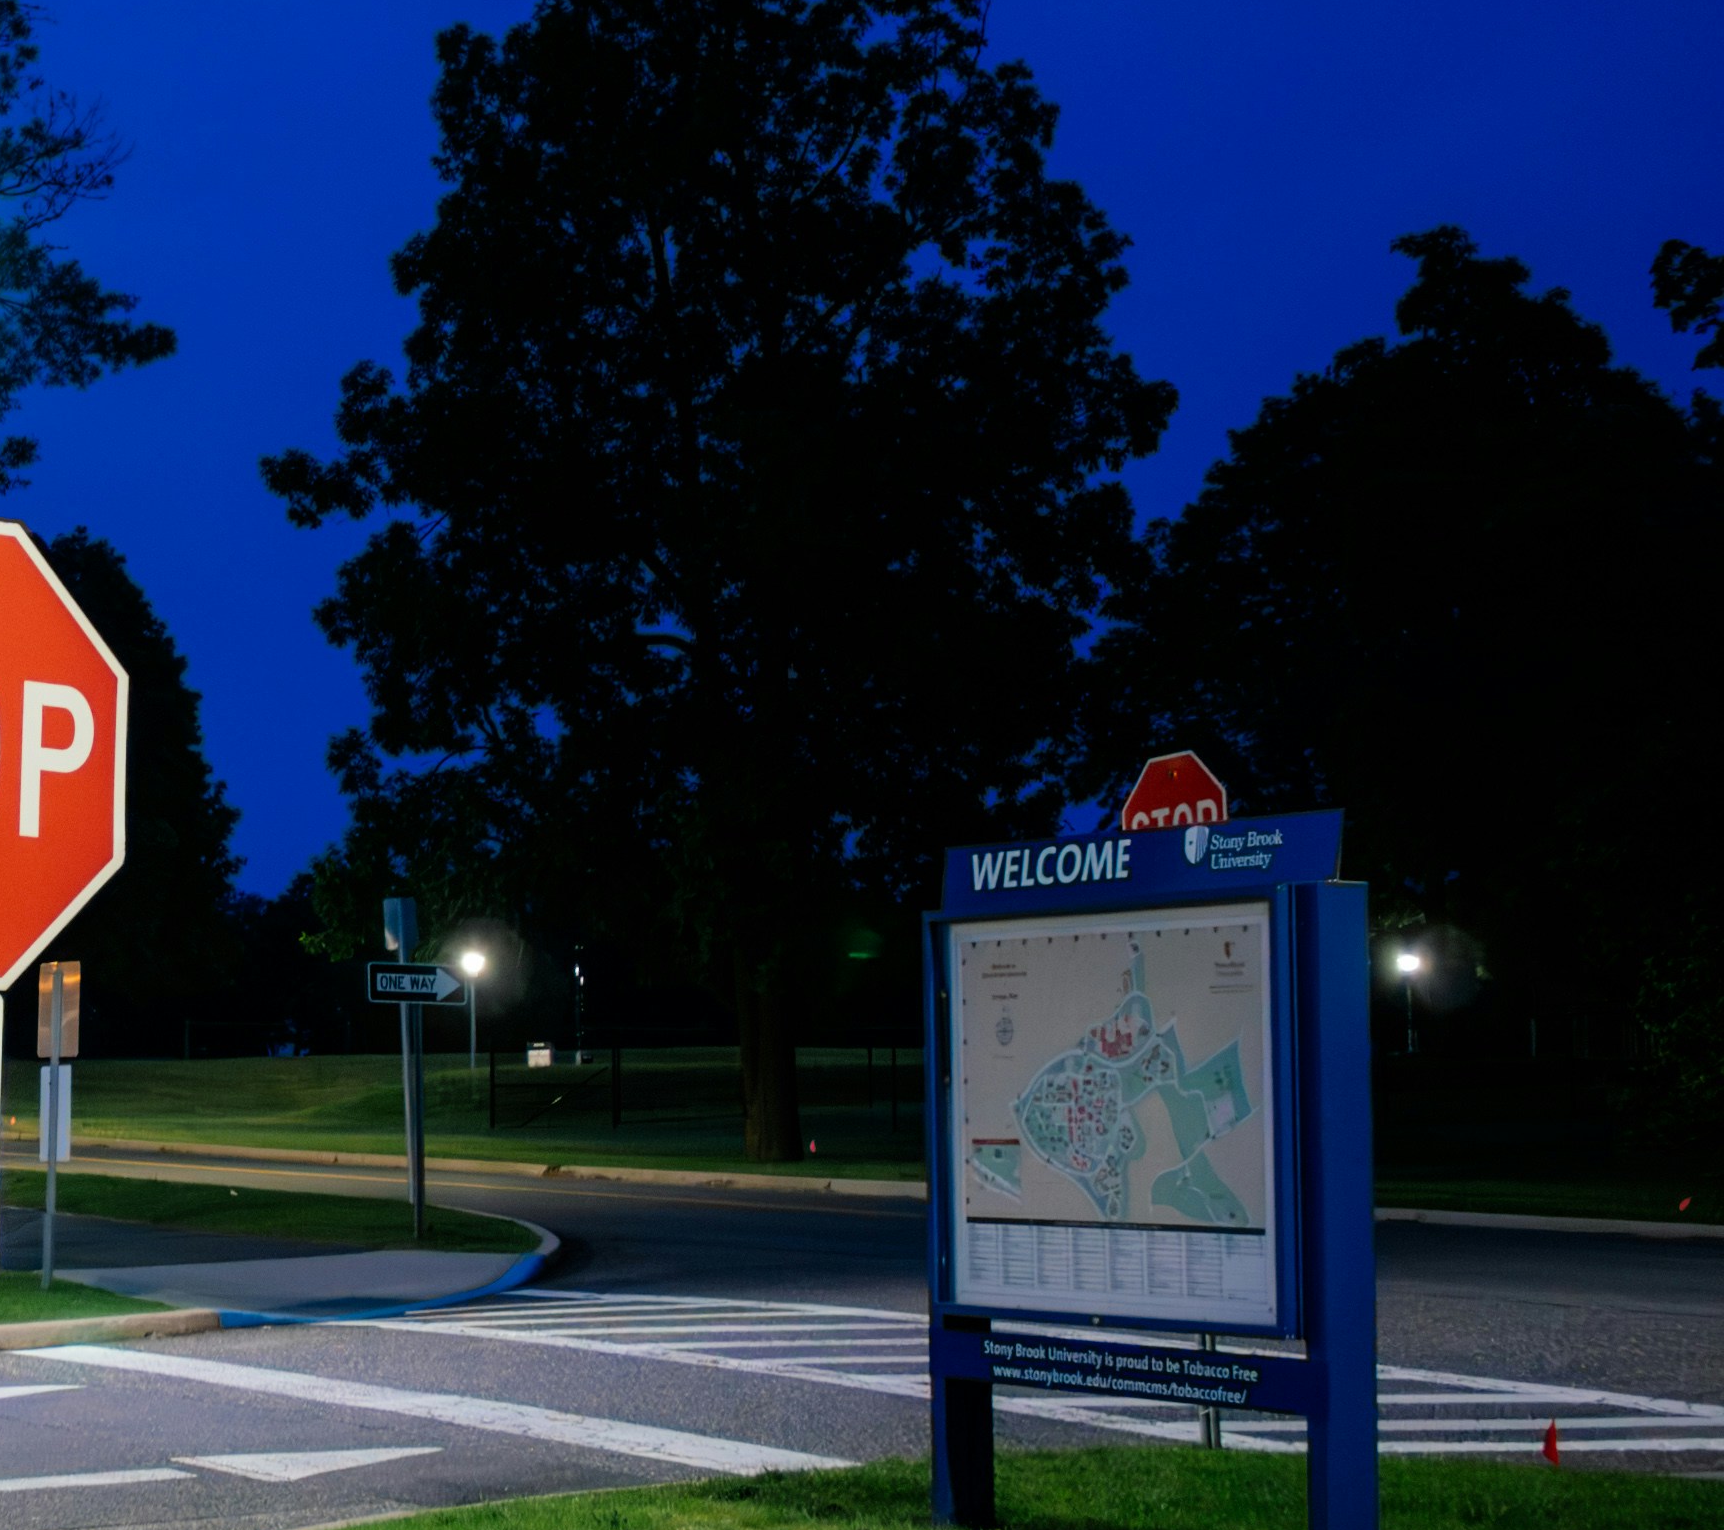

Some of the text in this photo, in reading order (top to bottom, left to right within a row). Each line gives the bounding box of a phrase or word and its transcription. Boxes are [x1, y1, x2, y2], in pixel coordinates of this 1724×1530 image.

[1210, 829, 1283, 851] Stony Brook
[972, 839, 1131, 891] WELCOME
[1210, 851, 1272, 869] University
[380, 975, 436, 990] ONE WAY
[984, 1340, 1258, 1381] Stony Brook University is proud to be Tobacco Free
[993, 1365, 1247, 1403] www.stonybrook.edu/commcms/tobaccofree/
